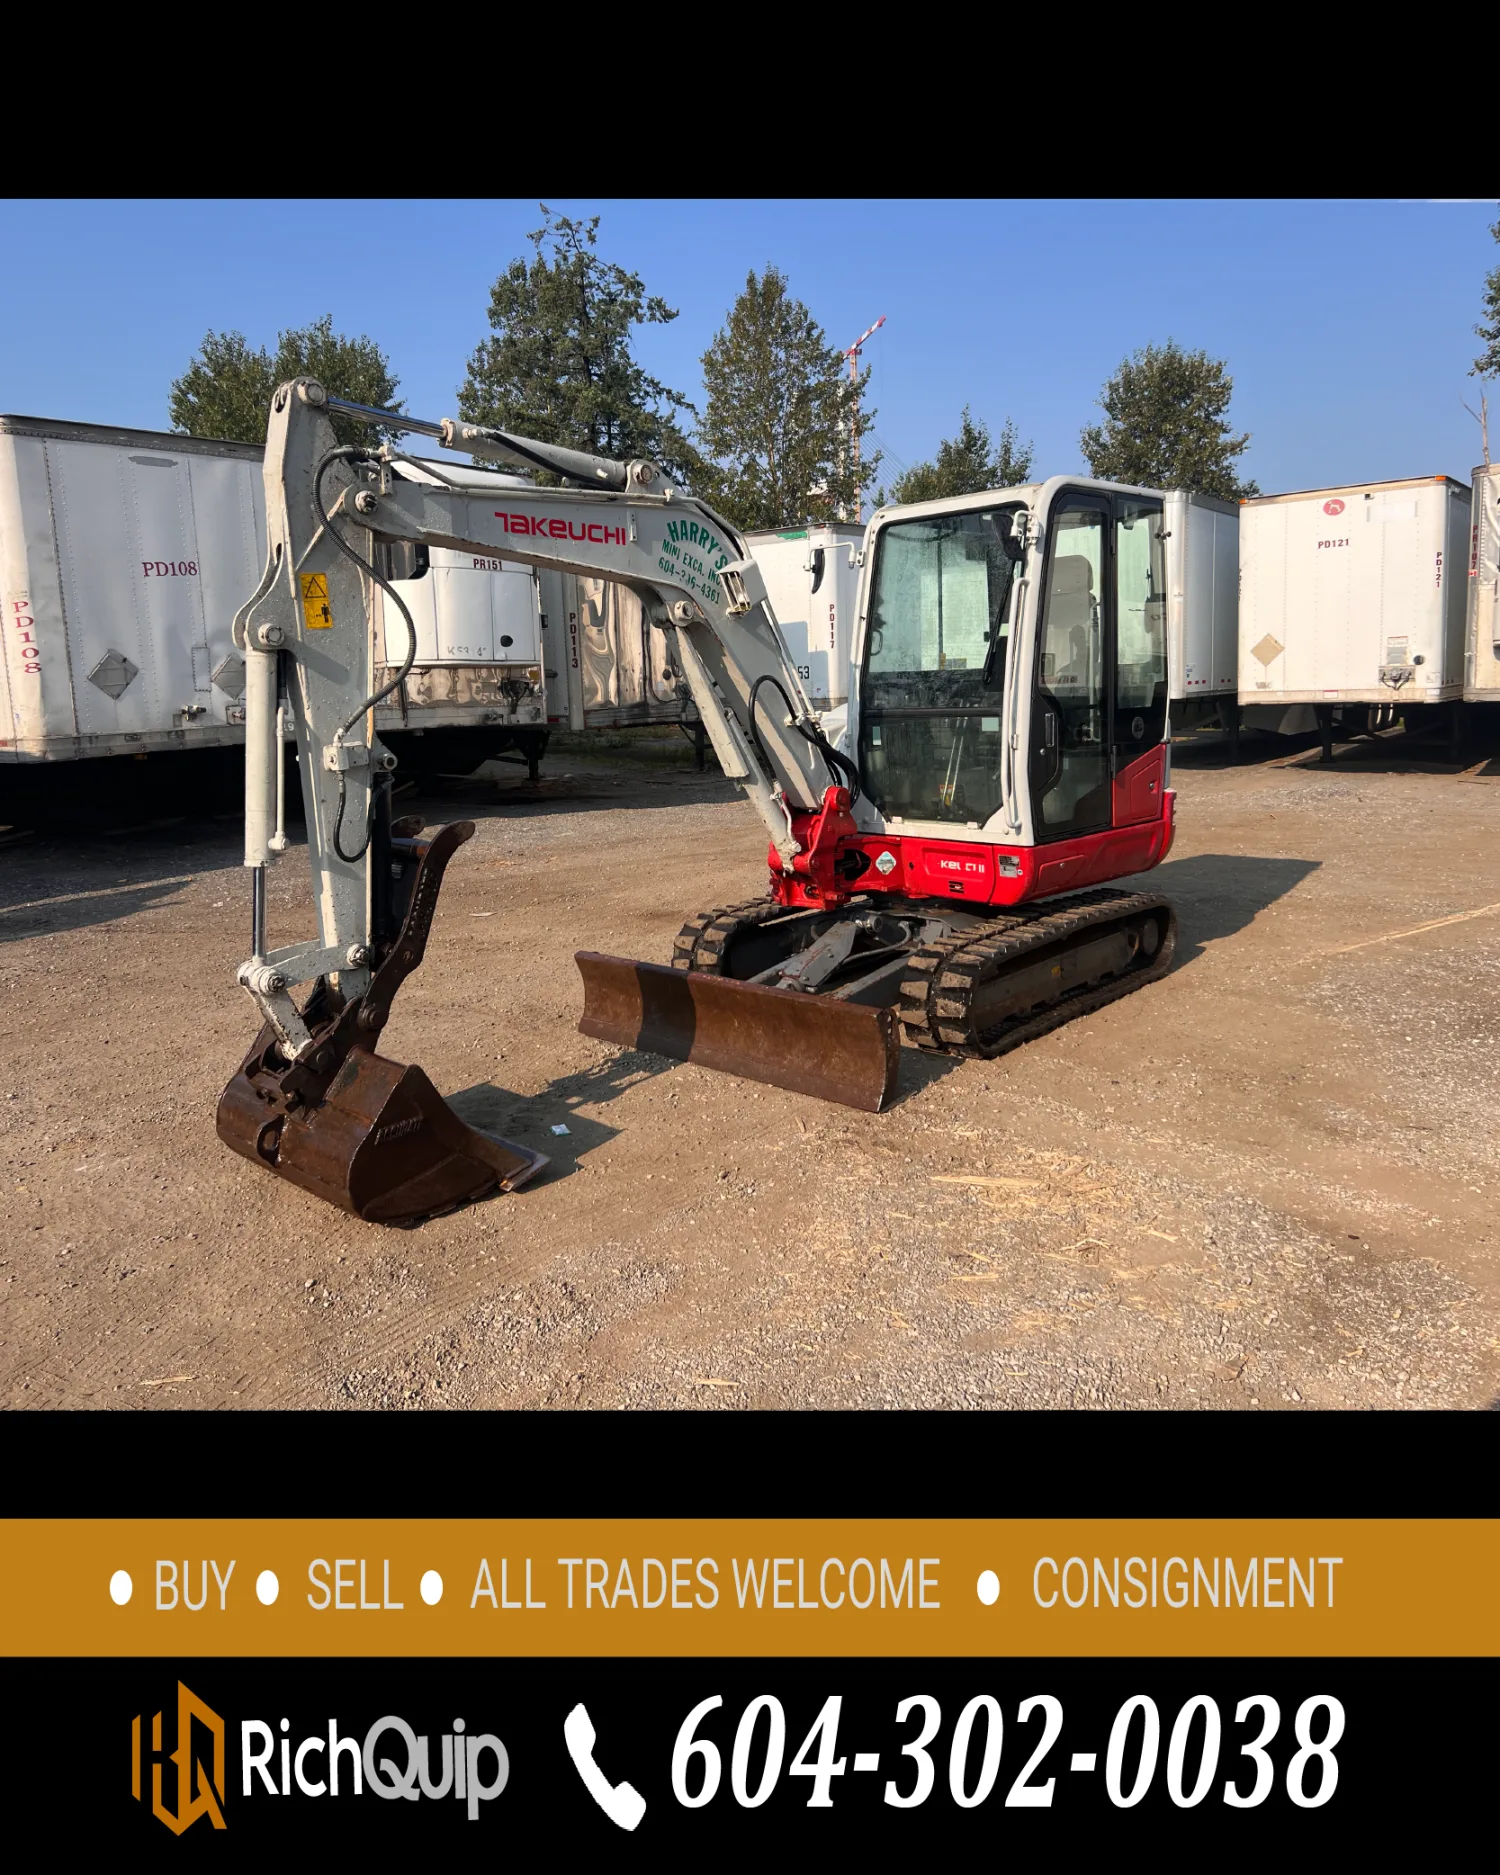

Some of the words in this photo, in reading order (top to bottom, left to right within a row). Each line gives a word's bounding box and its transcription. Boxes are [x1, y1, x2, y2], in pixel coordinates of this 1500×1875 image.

[494, 511, 626, 546] TAKEUCHI
[666, 520, 728, 571] HARRY'S
[1318, 538, 1350, 549] PD121
[142, 561, 198, 577] PD108
[473, 558, 503, 571] PR151
[661, 538, 681, 561] MINI
[682, 552, 705, 577] EXCA.
[1435, 551, 1443, 588] PD121
[12, 601, 42, 674] PD108
[569, 612, 579, 669] PD113
